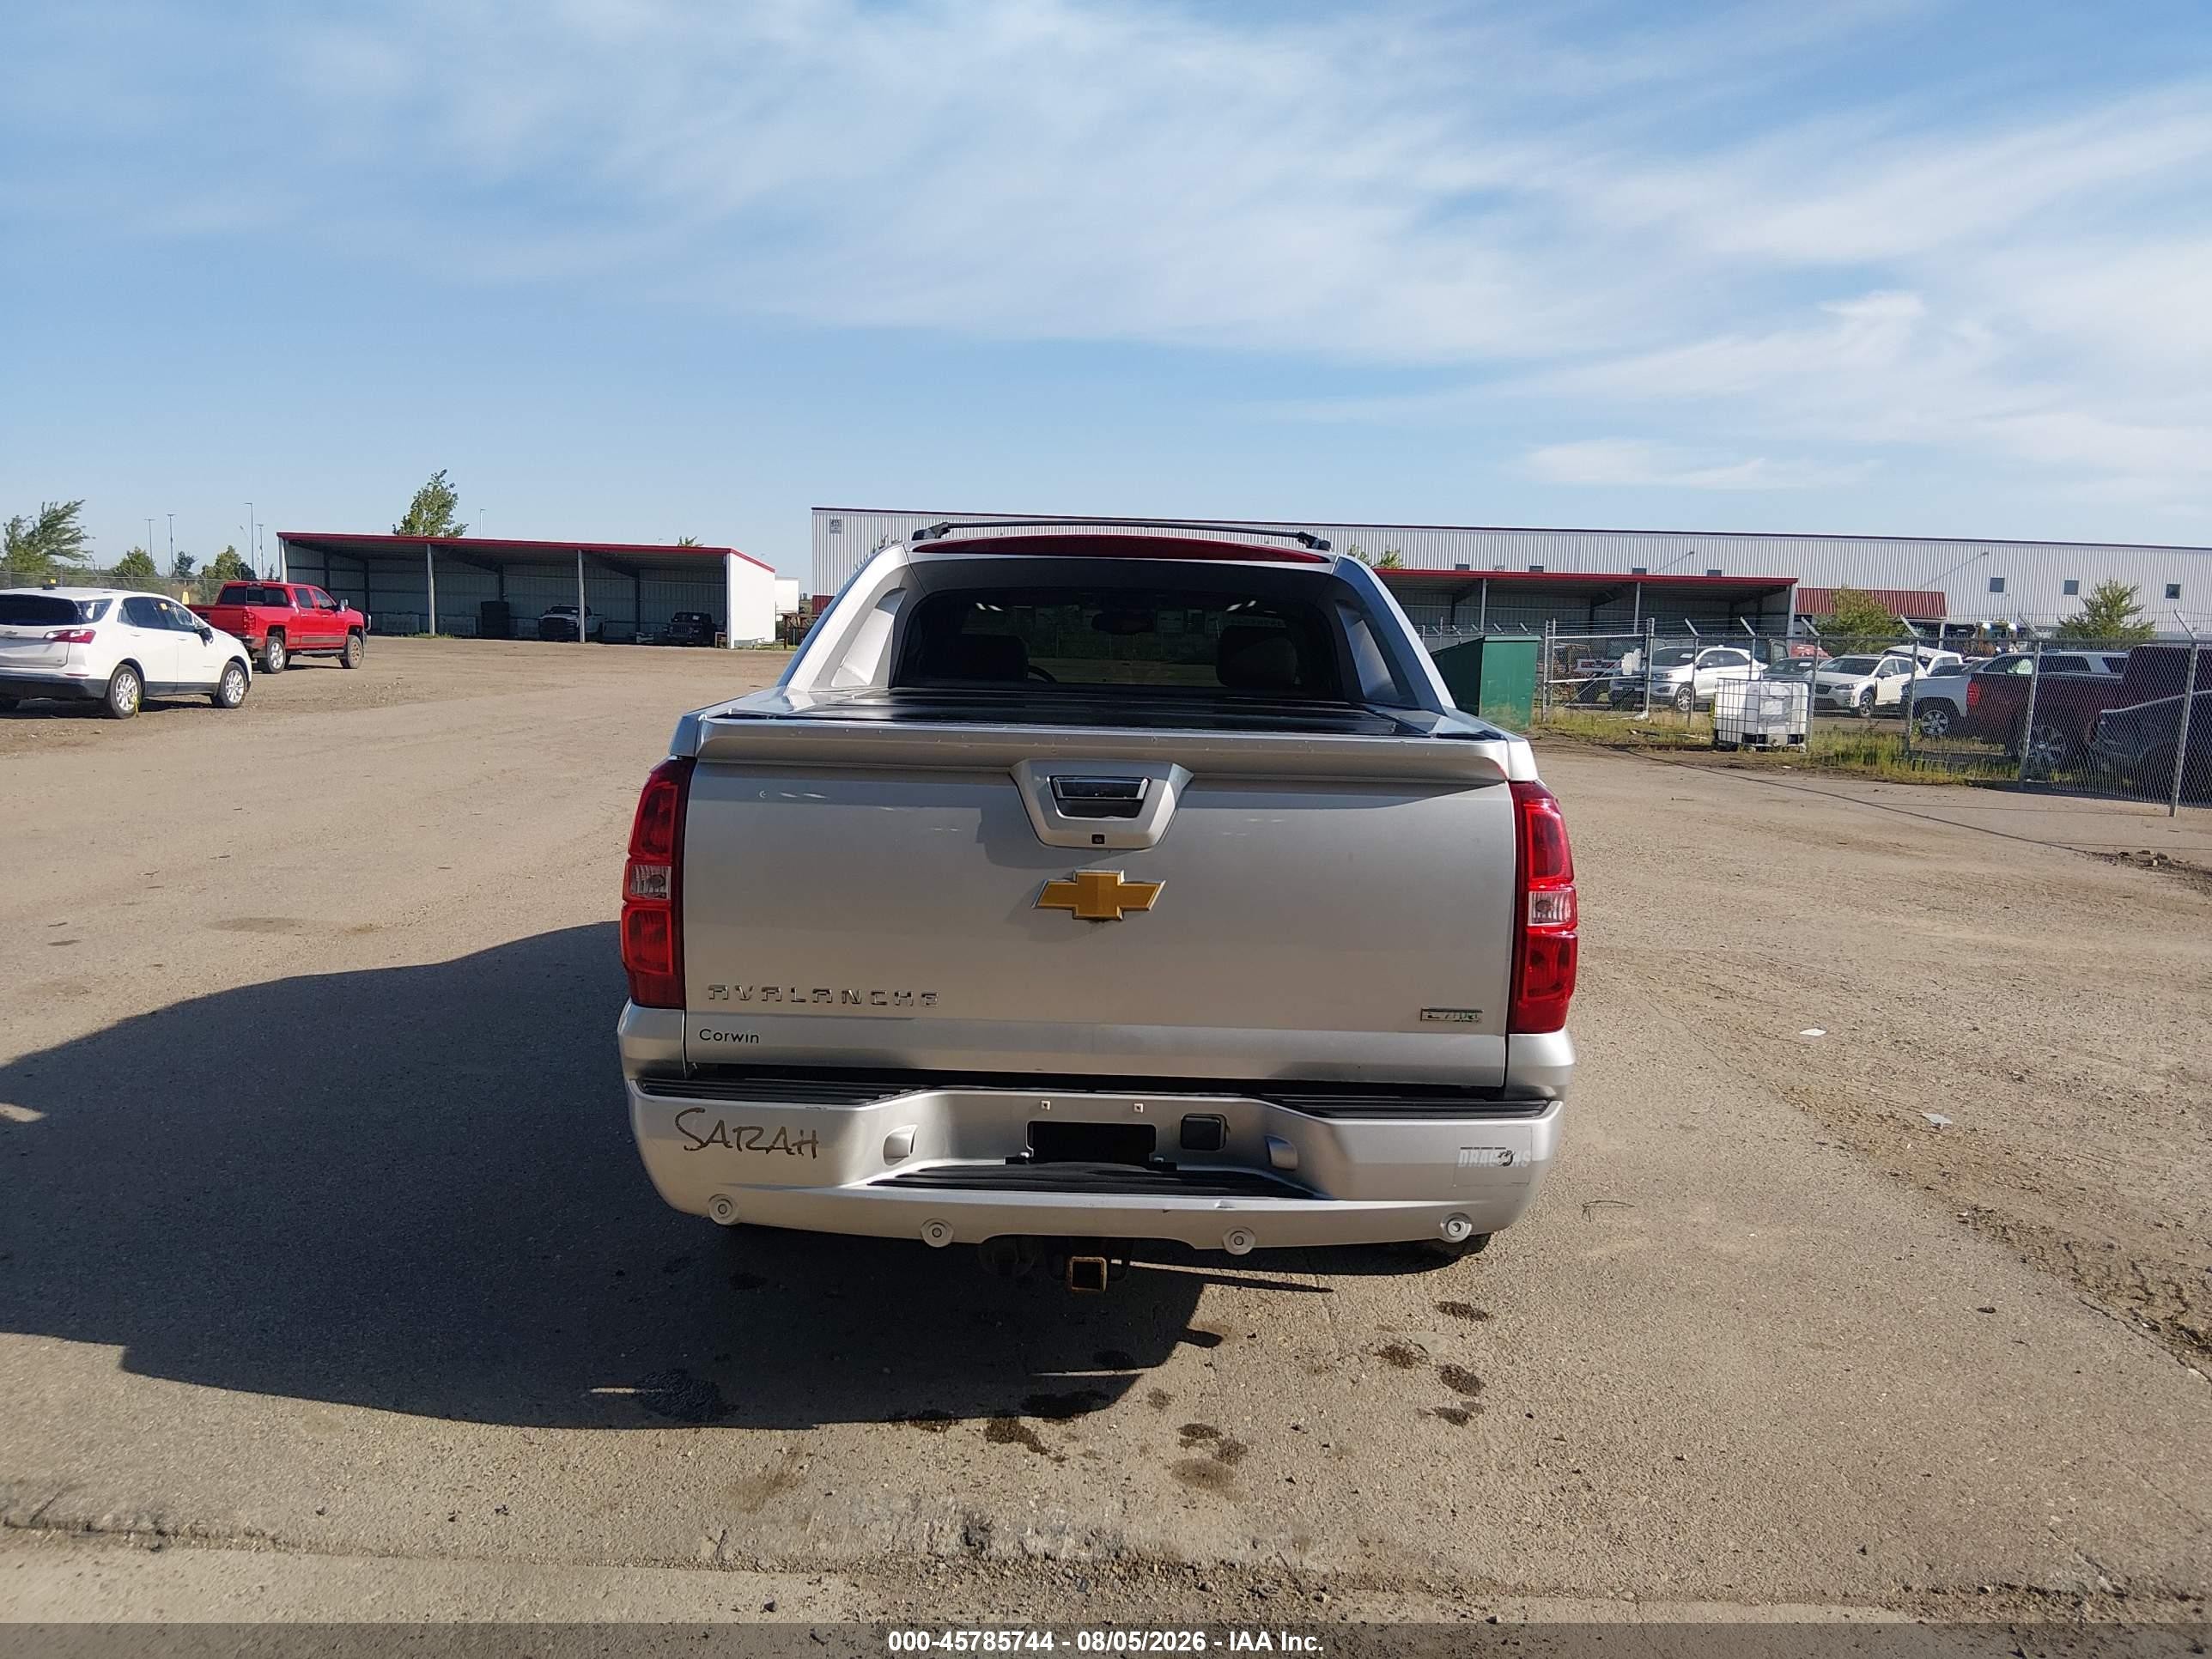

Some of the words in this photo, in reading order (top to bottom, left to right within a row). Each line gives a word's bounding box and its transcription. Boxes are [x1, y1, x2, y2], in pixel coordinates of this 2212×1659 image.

[707, 984, 939, 1007] AVALANCHE
[699, 1029, 760, 1044] Corwin
[675, 1107, 819, 1159] SARAH
[1457, 1149, 1532, 1168] DRAGNS
